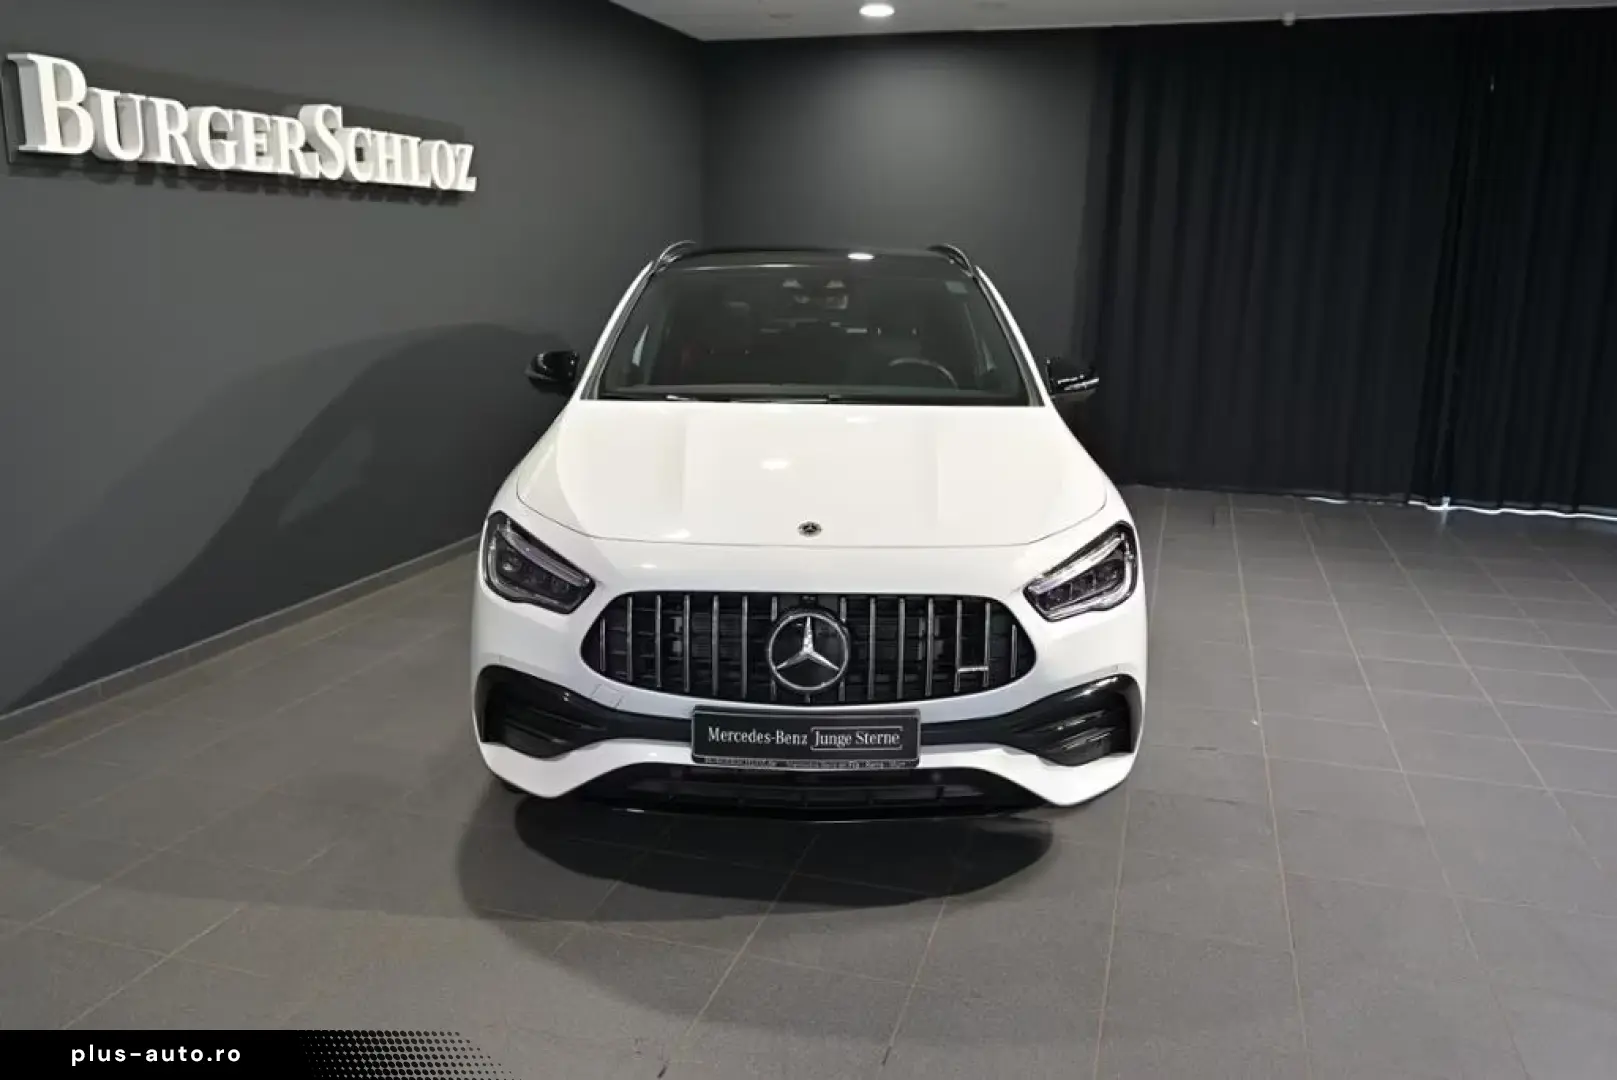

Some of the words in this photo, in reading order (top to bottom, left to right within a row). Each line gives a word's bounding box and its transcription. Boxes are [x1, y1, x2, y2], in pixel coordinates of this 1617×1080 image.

[708, 726, 808, 745] Mercedes-Benz
[815, 730, 852, 747] Junge
[855, 730, 900, 746] Sterne
